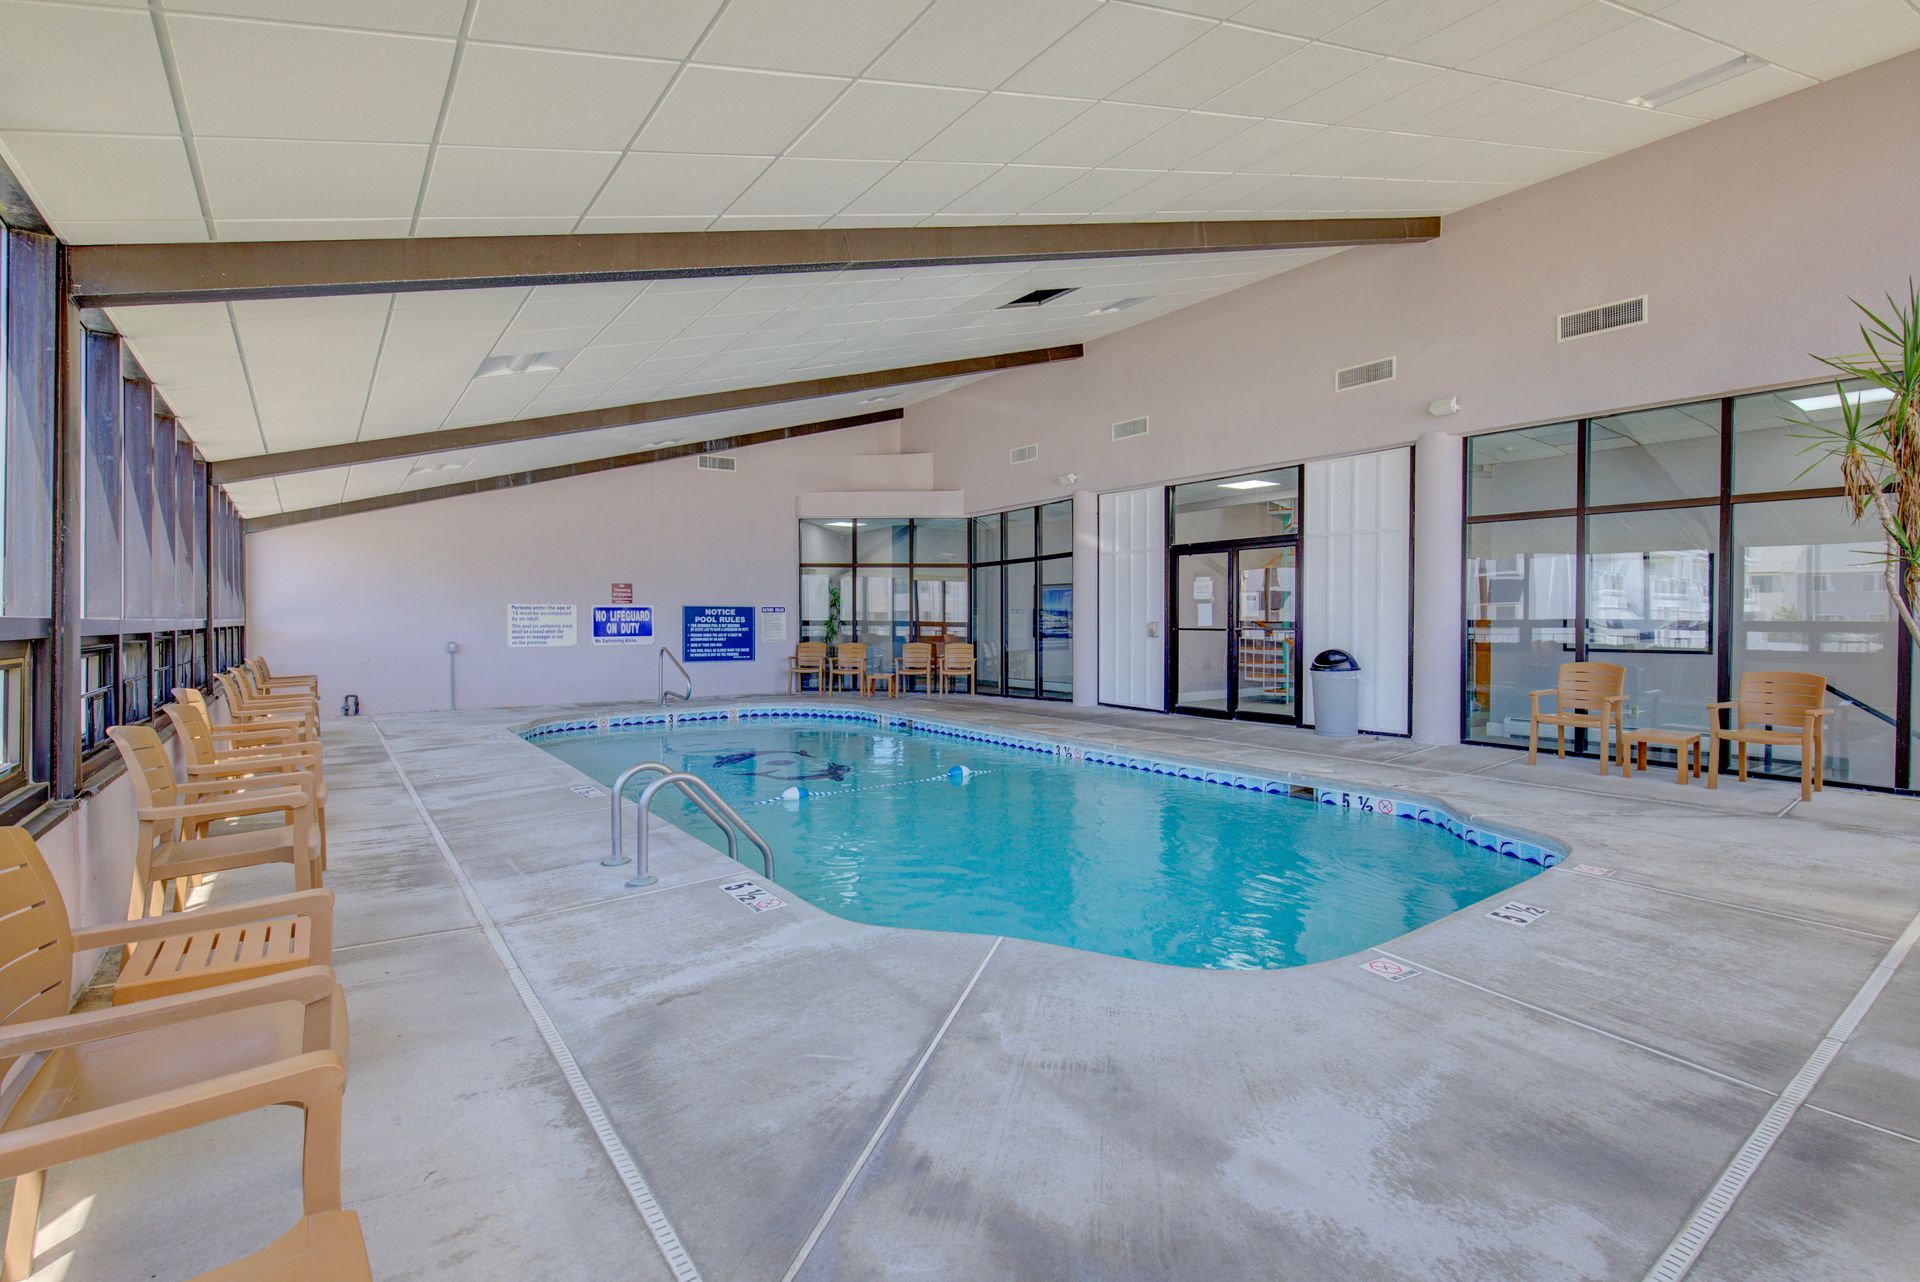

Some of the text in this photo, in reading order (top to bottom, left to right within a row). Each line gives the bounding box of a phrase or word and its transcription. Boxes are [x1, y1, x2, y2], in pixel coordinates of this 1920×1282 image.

[596, 610, 650, 622] NO LIFEGUARD
[607, 622, 640, 634] ON DUTY
[669, 714, 673, 723] 3
[1342, 793, 1350, 807] 5
[724, 882, 753, 890] 5
[1491, 912, 1528, 923] 5
